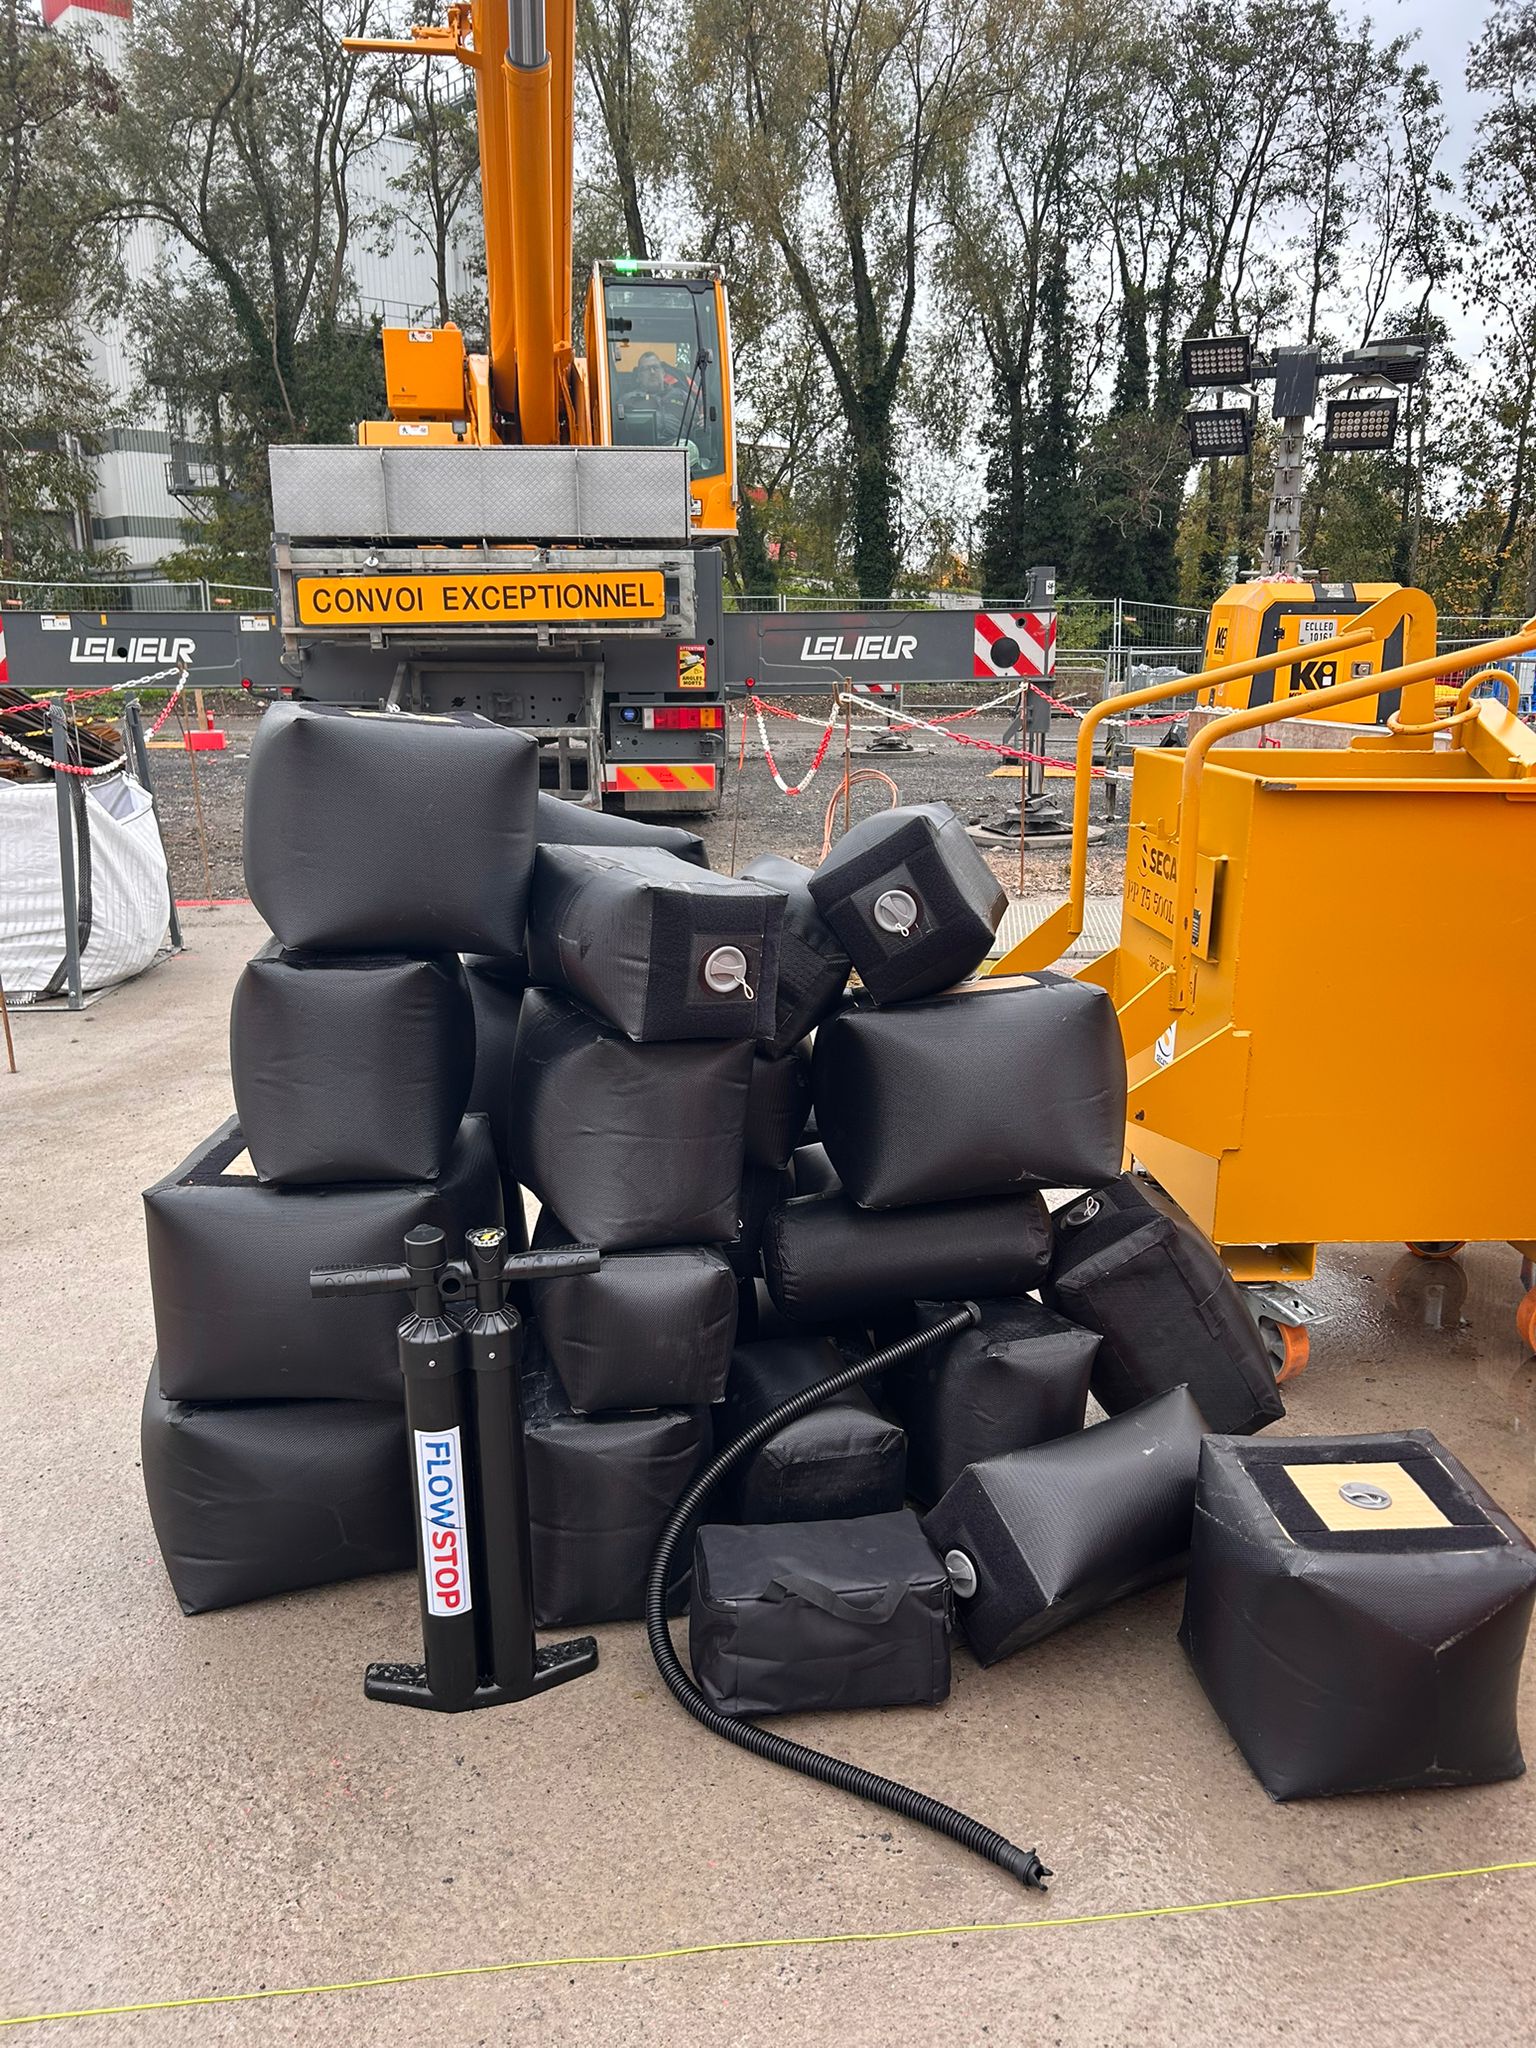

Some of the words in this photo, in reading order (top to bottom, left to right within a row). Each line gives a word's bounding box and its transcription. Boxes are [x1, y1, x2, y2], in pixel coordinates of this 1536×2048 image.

[312, 587, 423, 614] CONVOI
[443, 583, 655, 611] EXCEPTIONNEL
[1305, 621, 1334, 631] ECLLED
[69, 637, 197, 663] LELIEUR
[800, 634, 918, 661] LELIEUR
